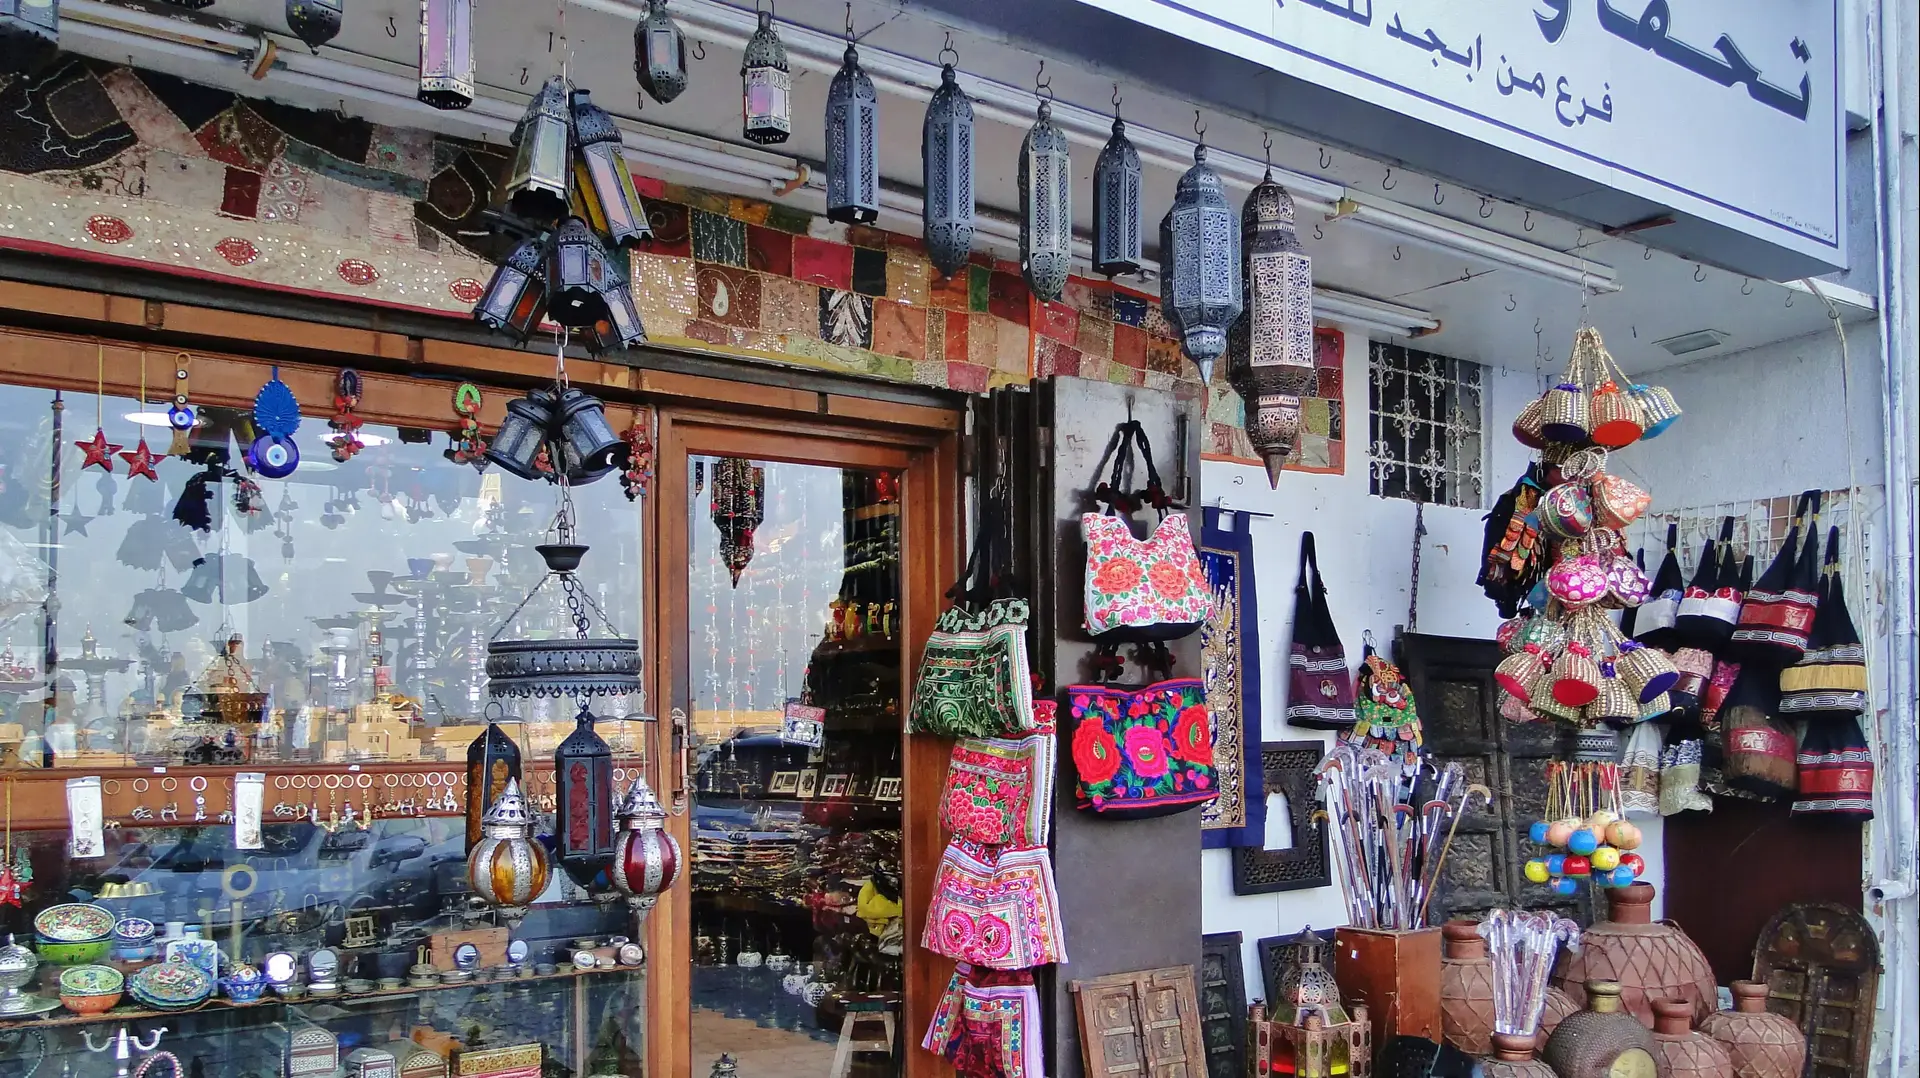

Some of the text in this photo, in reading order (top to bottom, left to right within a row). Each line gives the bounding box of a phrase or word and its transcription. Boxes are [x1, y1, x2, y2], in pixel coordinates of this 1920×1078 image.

[1386, 12, 1482, 83] ابجد
[1496, 54, 1546, 99] من
[1555, 75, 1613, 128] فرع
